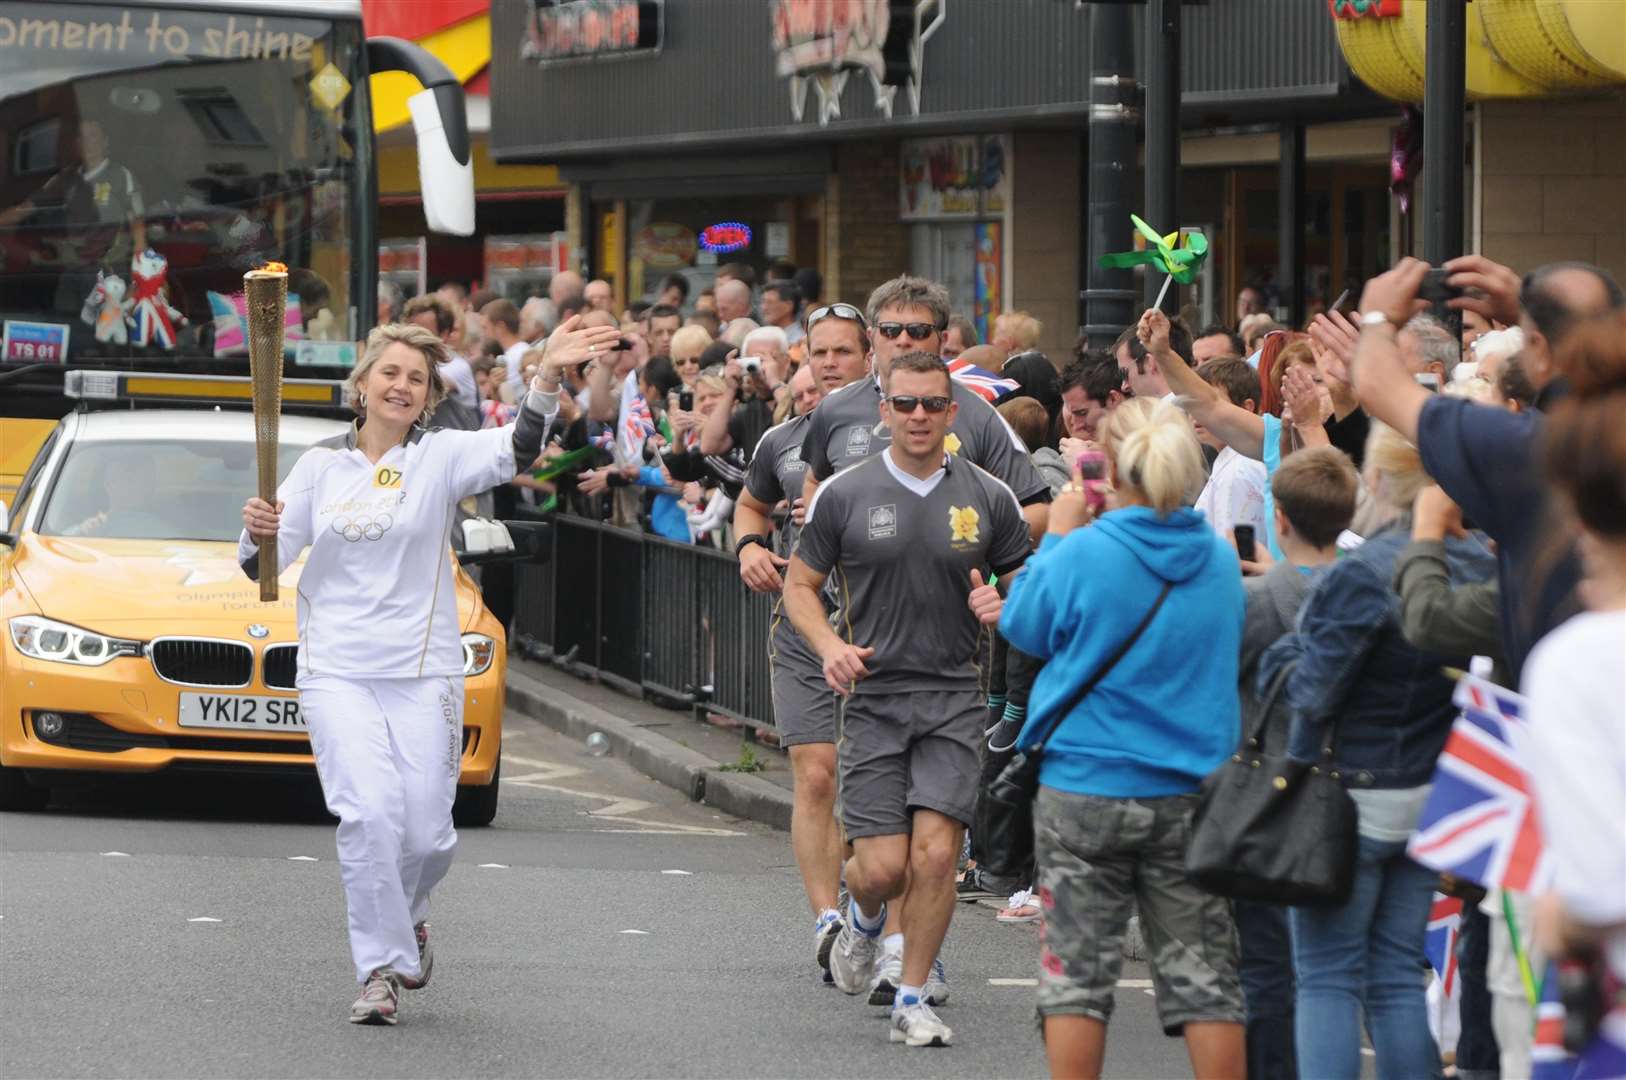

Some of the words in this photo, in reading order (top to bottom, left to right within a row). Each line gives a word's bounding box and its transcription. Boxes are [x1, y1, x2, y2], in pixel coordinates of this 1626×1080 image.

[146, 12, 190, 54] to
[204, 16, 315, 60] shine
[15, 342, 34, 358] TS
[378, 468, 403, 486] 07
